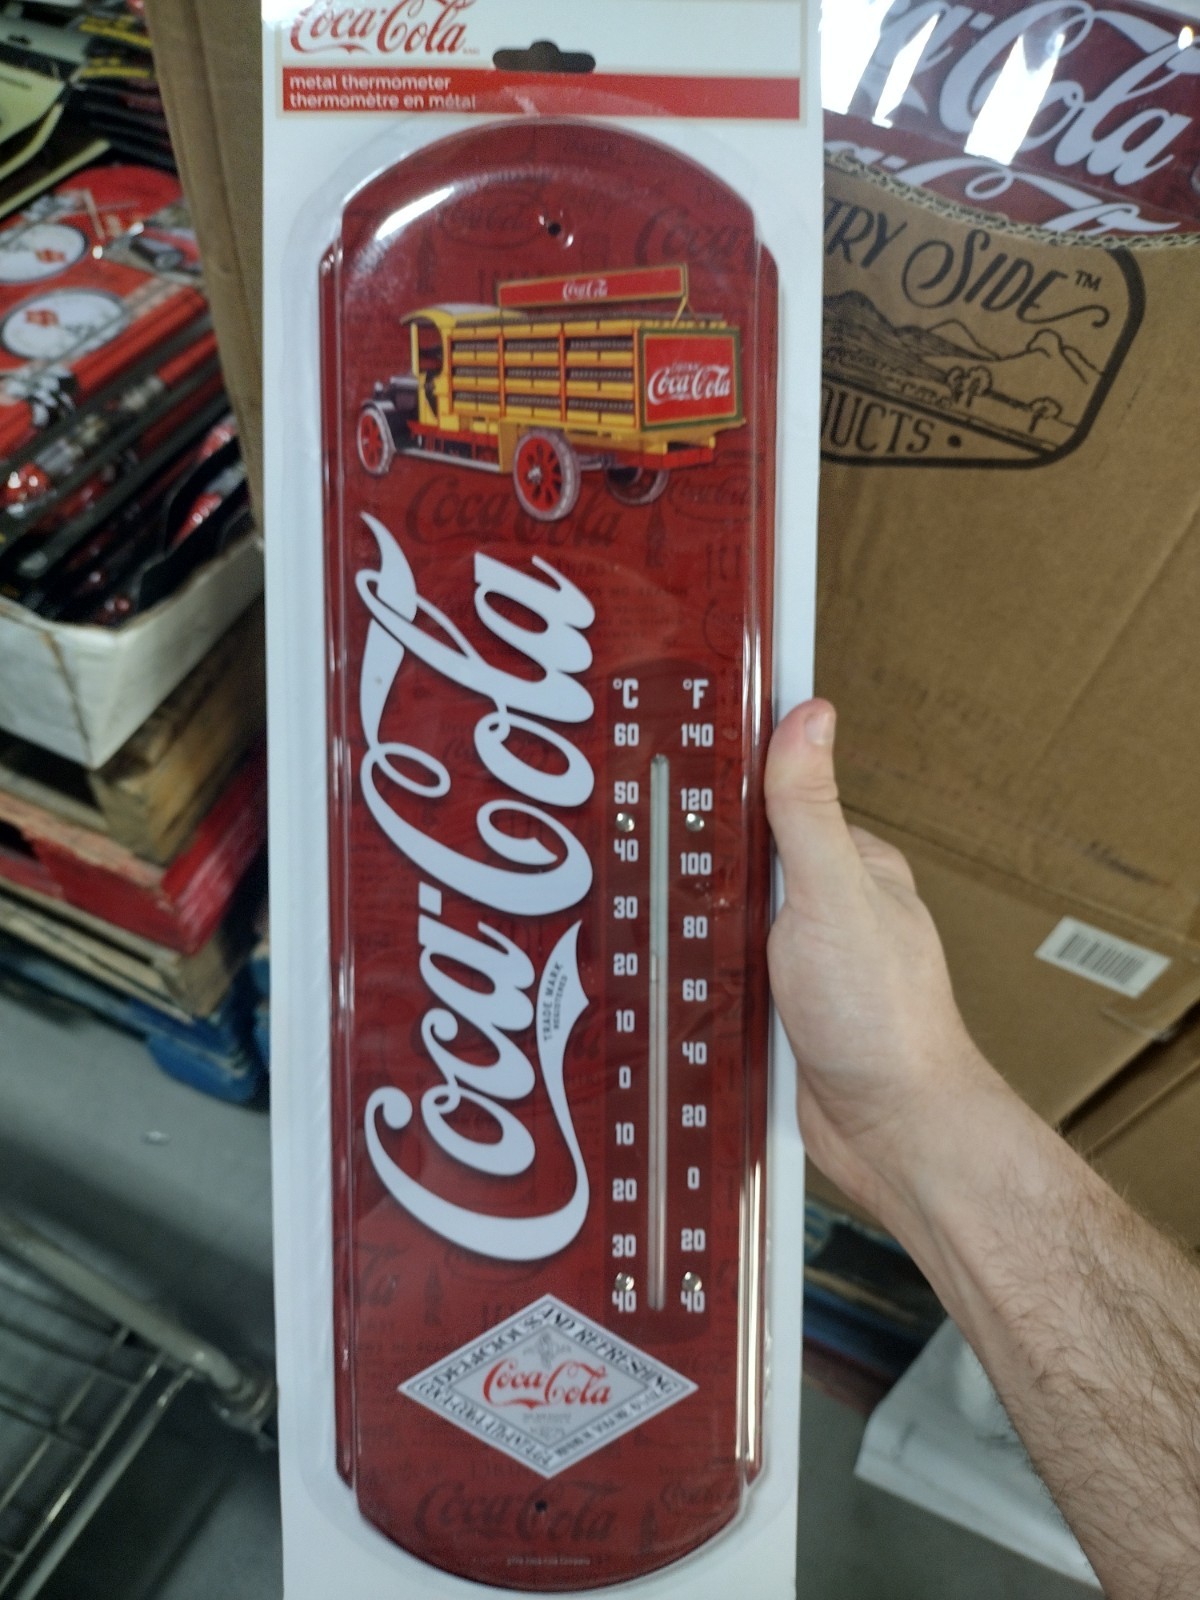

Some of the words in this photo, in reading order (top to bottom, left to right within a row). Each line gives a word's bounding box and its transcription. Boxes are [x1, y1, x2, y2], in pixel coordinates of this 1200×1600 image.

[290, 75, 337, 90] metal
[341, 75, 451, 91] thermometer
[290, 93, 400, 109] thermomètre
[404, 96, 424, 108] en
[428, 94, 476, 110] métal
[824, 197, 908, 269] TRY
[614, 723, 639, 746] 60
[681, 723, 714, 747] 140
[614, 781, 639, 804] 50
[681, 788, 713, 811] 120
[613, 839, 639, 861] 40
[680, 852, 712, 875] 100
[355, 511, 596, 1262] Coca-Cola
[613, 896, 638, 919] 30
[683, 916, 708, 938] 80
[613, 953, 638, 976] 20
[682, 979, 707, 1001] 60
[616, 1009, 635, 1032] 10
[682, 1042, 707, 1064] 40
[619, 1066, 631, 1088] 0
[682, 1104, 707, 1127] 20
[616, 1122, 634, 1145] 10
[687, 1166, 700, 1189] 0
[612, 1178, 637, 1201] 20
[612, 1234, 637, 1257] 30
[681, 1228, 706, 1251] 20
[611, 1290, 637, 1312] 40
[680, 1289, 705, 1312] 40
[483, 1357, 611, 1410] Coca-Cola
